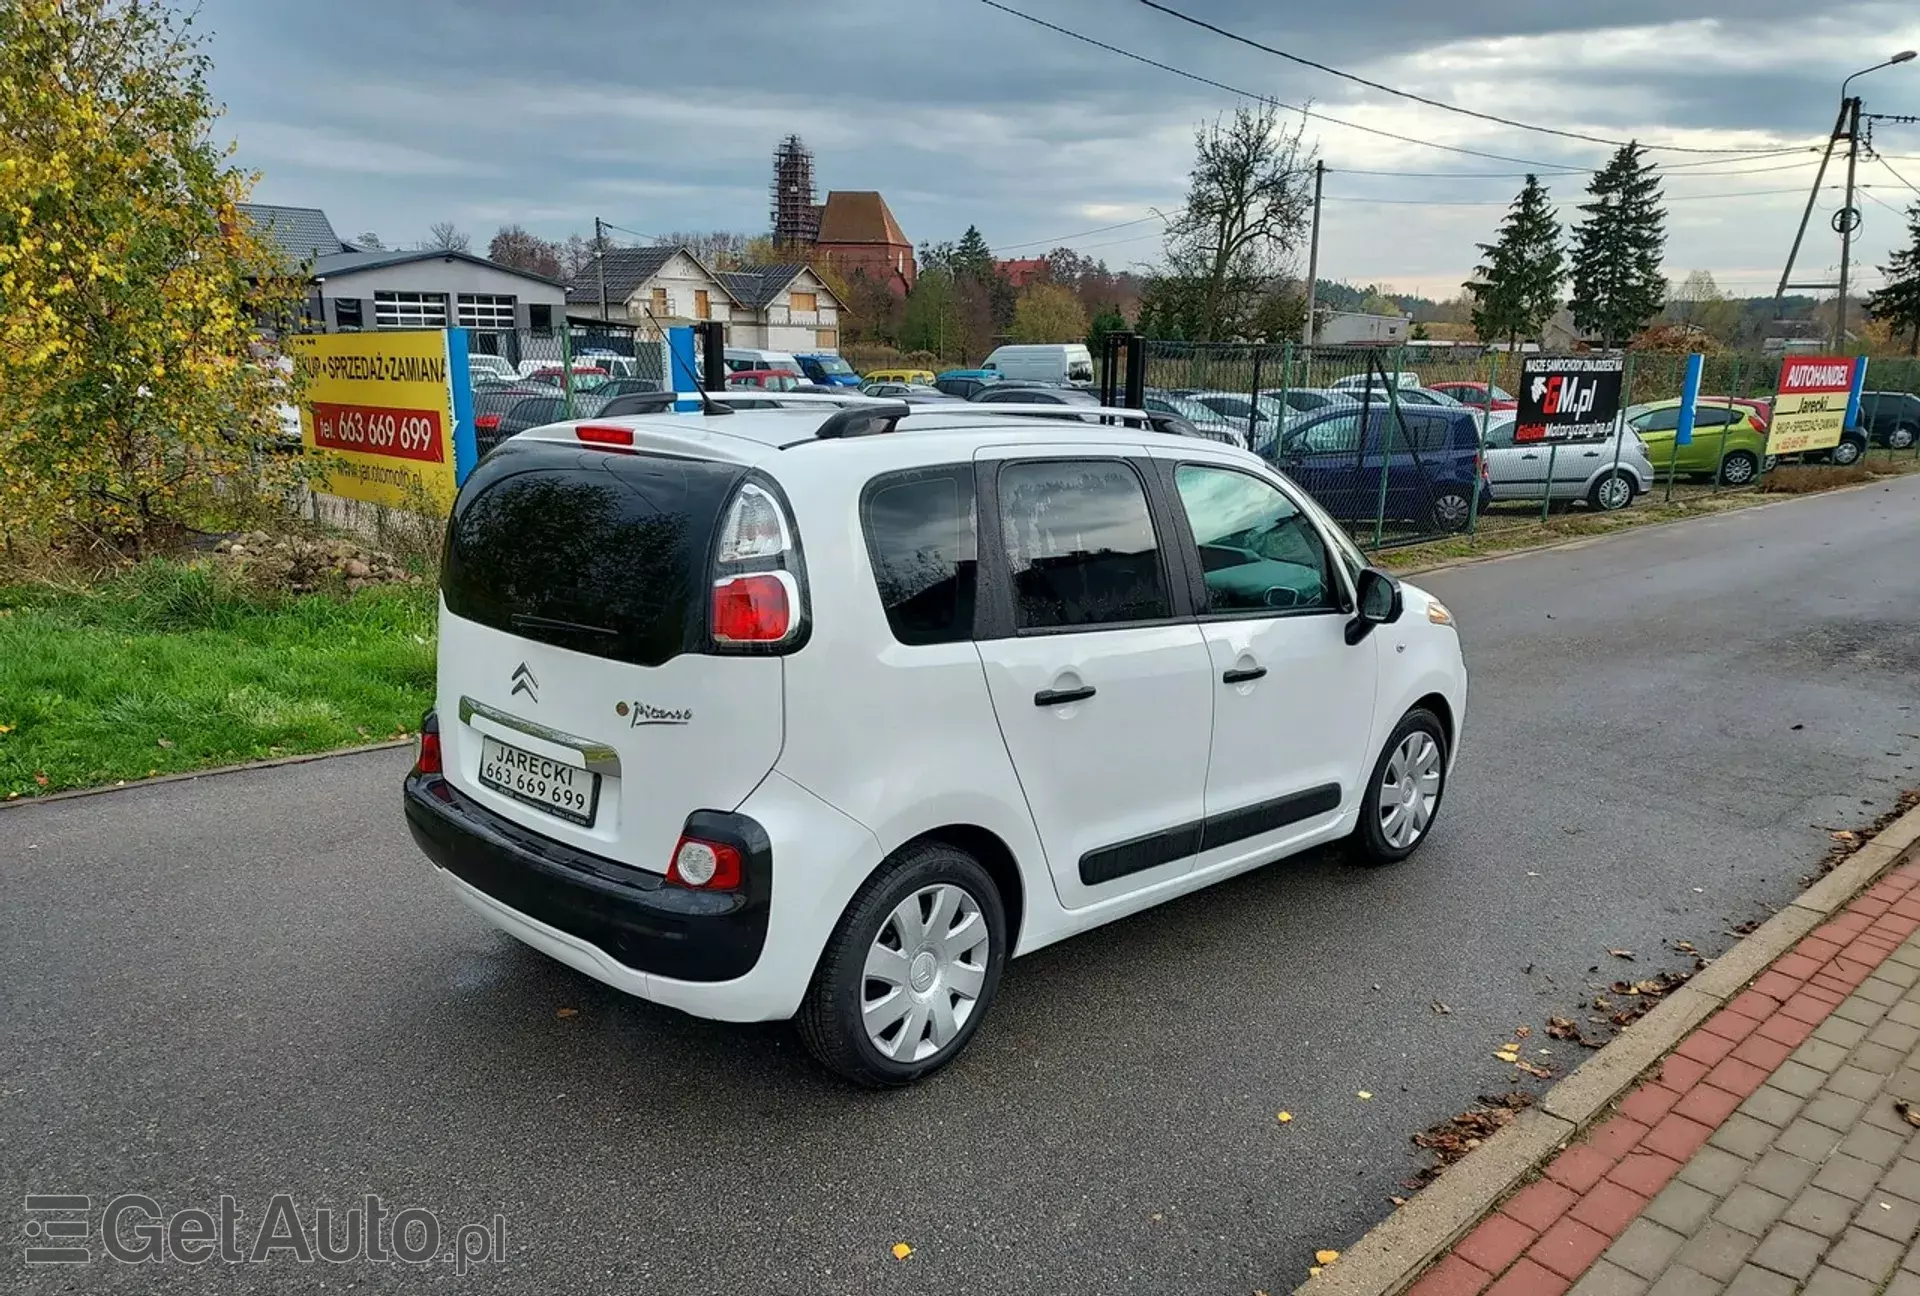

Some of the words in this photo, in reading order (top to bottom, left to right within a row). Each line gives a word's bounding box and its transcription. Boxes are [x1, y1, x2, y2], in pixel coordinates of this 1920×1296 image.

[328, 352, 385, 381] SPRZEDAŻ
[1786, 365, 1848, 387] AUTOHANDEL
[1543, 376, 1597, 421] GM.pl
[1798, 396, 1829, 414] Jarecki
[320, 418, 336, 439] tel.
[339, 411, 364, 443] 663
[368, 414, 396, 446] 669
[400, 417, 431, 451] 699
[486, 762, 512, 785] 663
[516, 774, 546, 796] 669
[551, 786, 585, 810] 699
[496, 746, 573, 786] JARECKI
